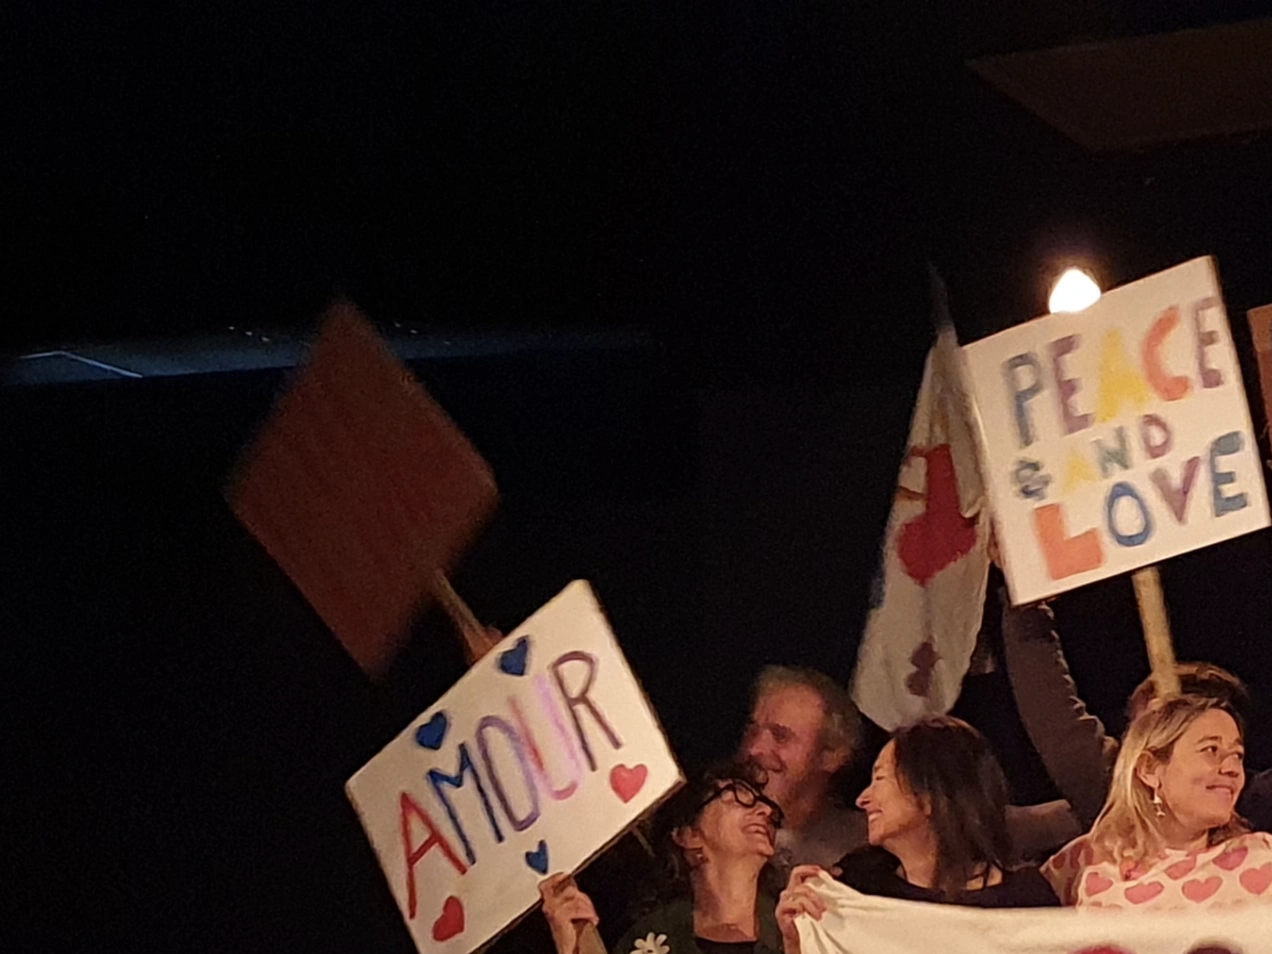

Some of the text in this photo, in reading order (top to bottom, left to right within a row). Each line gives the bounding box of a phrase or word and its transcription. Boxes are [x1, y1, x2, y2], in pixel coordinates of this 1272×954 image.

[1003, 297, 1223, 446] PEACE
[1034, 431, 1250, 580] LOVE
[1062, 413, 1174, 494] AND
[400, 651, 623, 919] AMOUR
